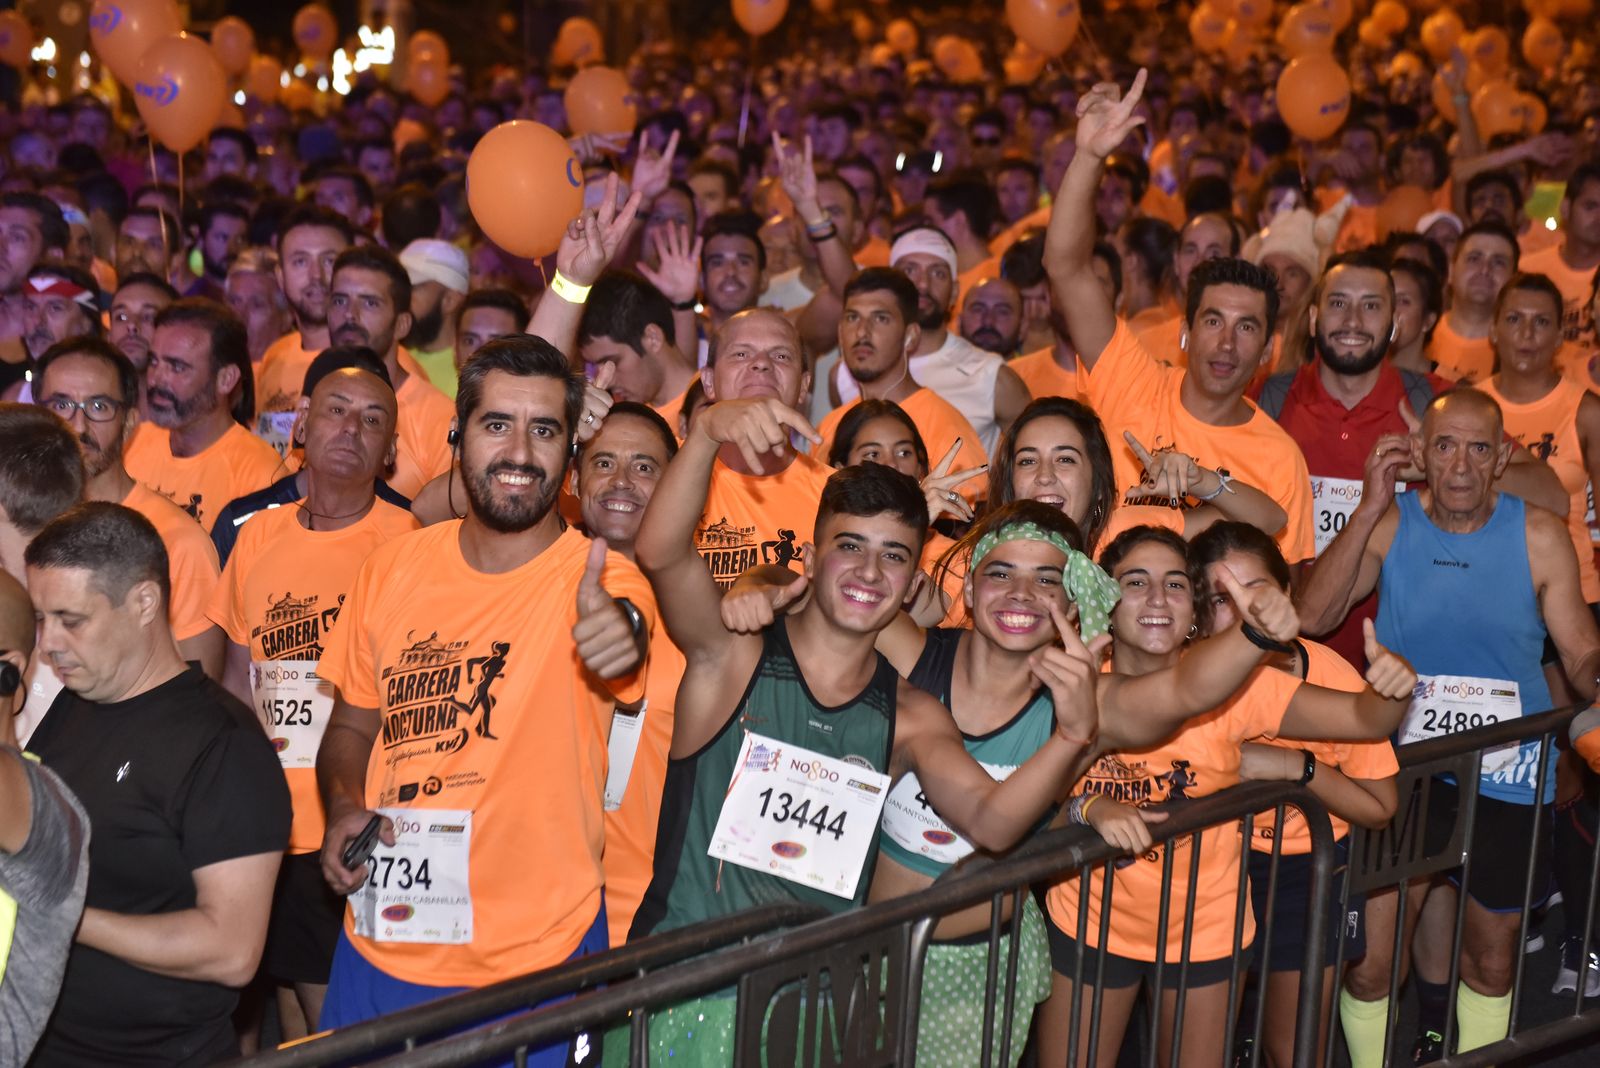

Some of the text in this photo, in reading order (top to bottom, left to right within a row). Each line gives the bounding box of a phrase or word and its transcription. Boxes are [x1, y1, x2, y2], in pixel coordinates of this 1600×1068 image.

[1331, 485, 1361, 500] NO8D
[1319, 510, 1353, 533] 30
[704, 548, 757, 575] ARRERA
[262, 617, 319, 658] CARRERA
[387, 665, 461, 707] CARRERA
[263, 699, 312, 726] 11525
[383, 703, 459, 745] NOCTURNA
[1083, 779, 1152, 801] CARRERA
[759, 787, 849, 841] 13444
[902, 806, 940, 828] ANTONIO
[381, 893, 411, 903] JAVIER
[415, 894, 469, 906] CABANILLAS
